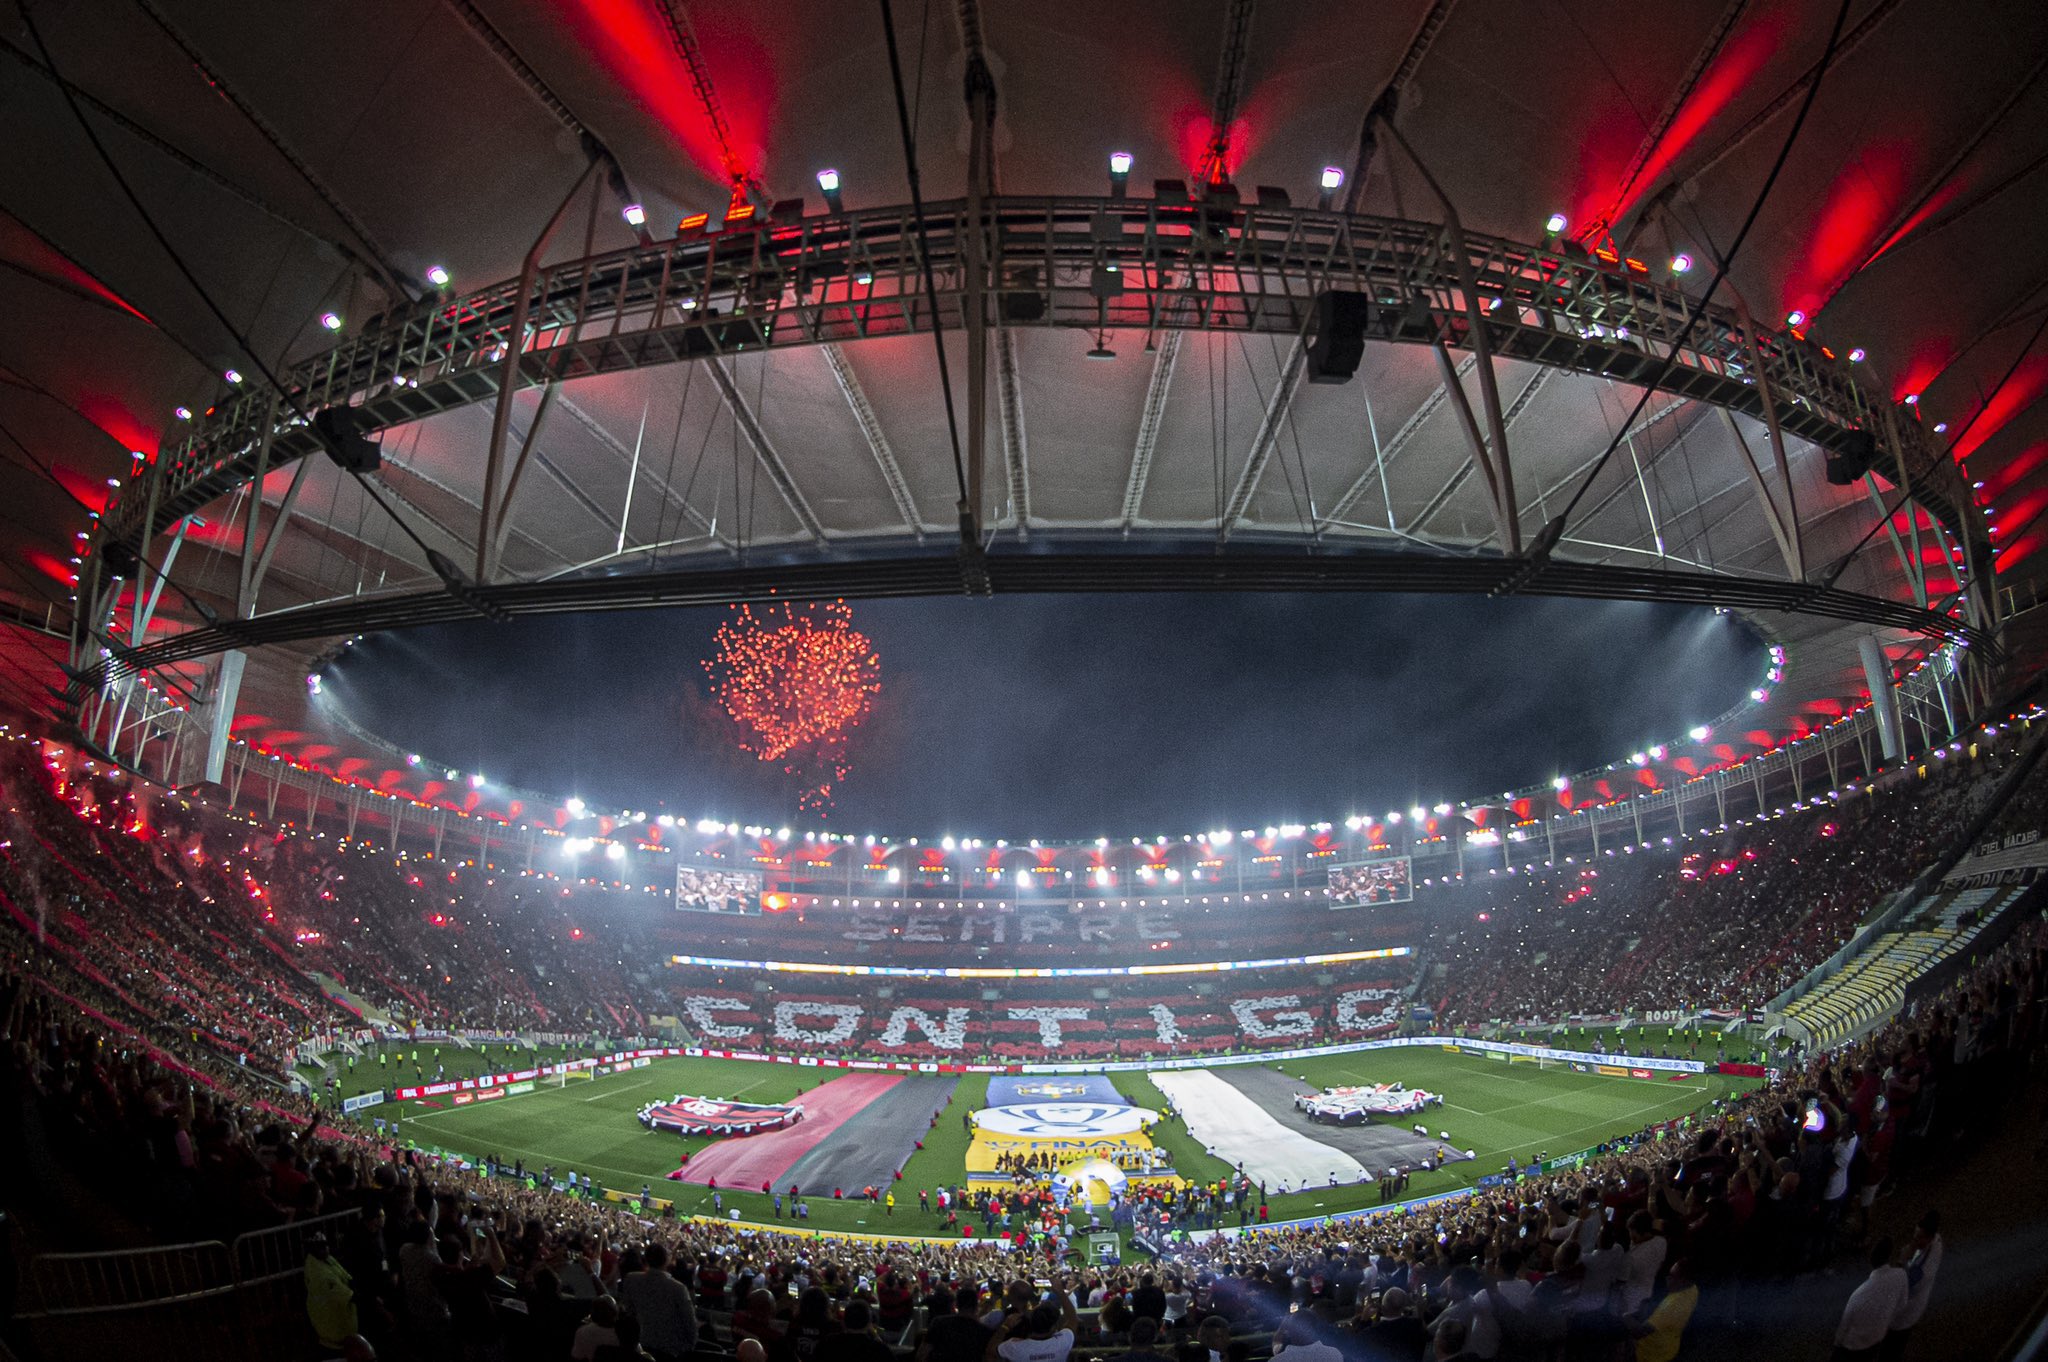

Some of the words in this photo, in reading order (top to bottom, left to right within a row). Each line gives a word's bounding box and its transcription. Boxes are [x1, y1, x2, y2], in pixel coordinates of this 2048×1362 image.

[843, 913, 1182, 943] SEMPRE
[684, 988, 1401, 1049] CONTIGO
[1030, 1140, 1139, 1150] FINAL
